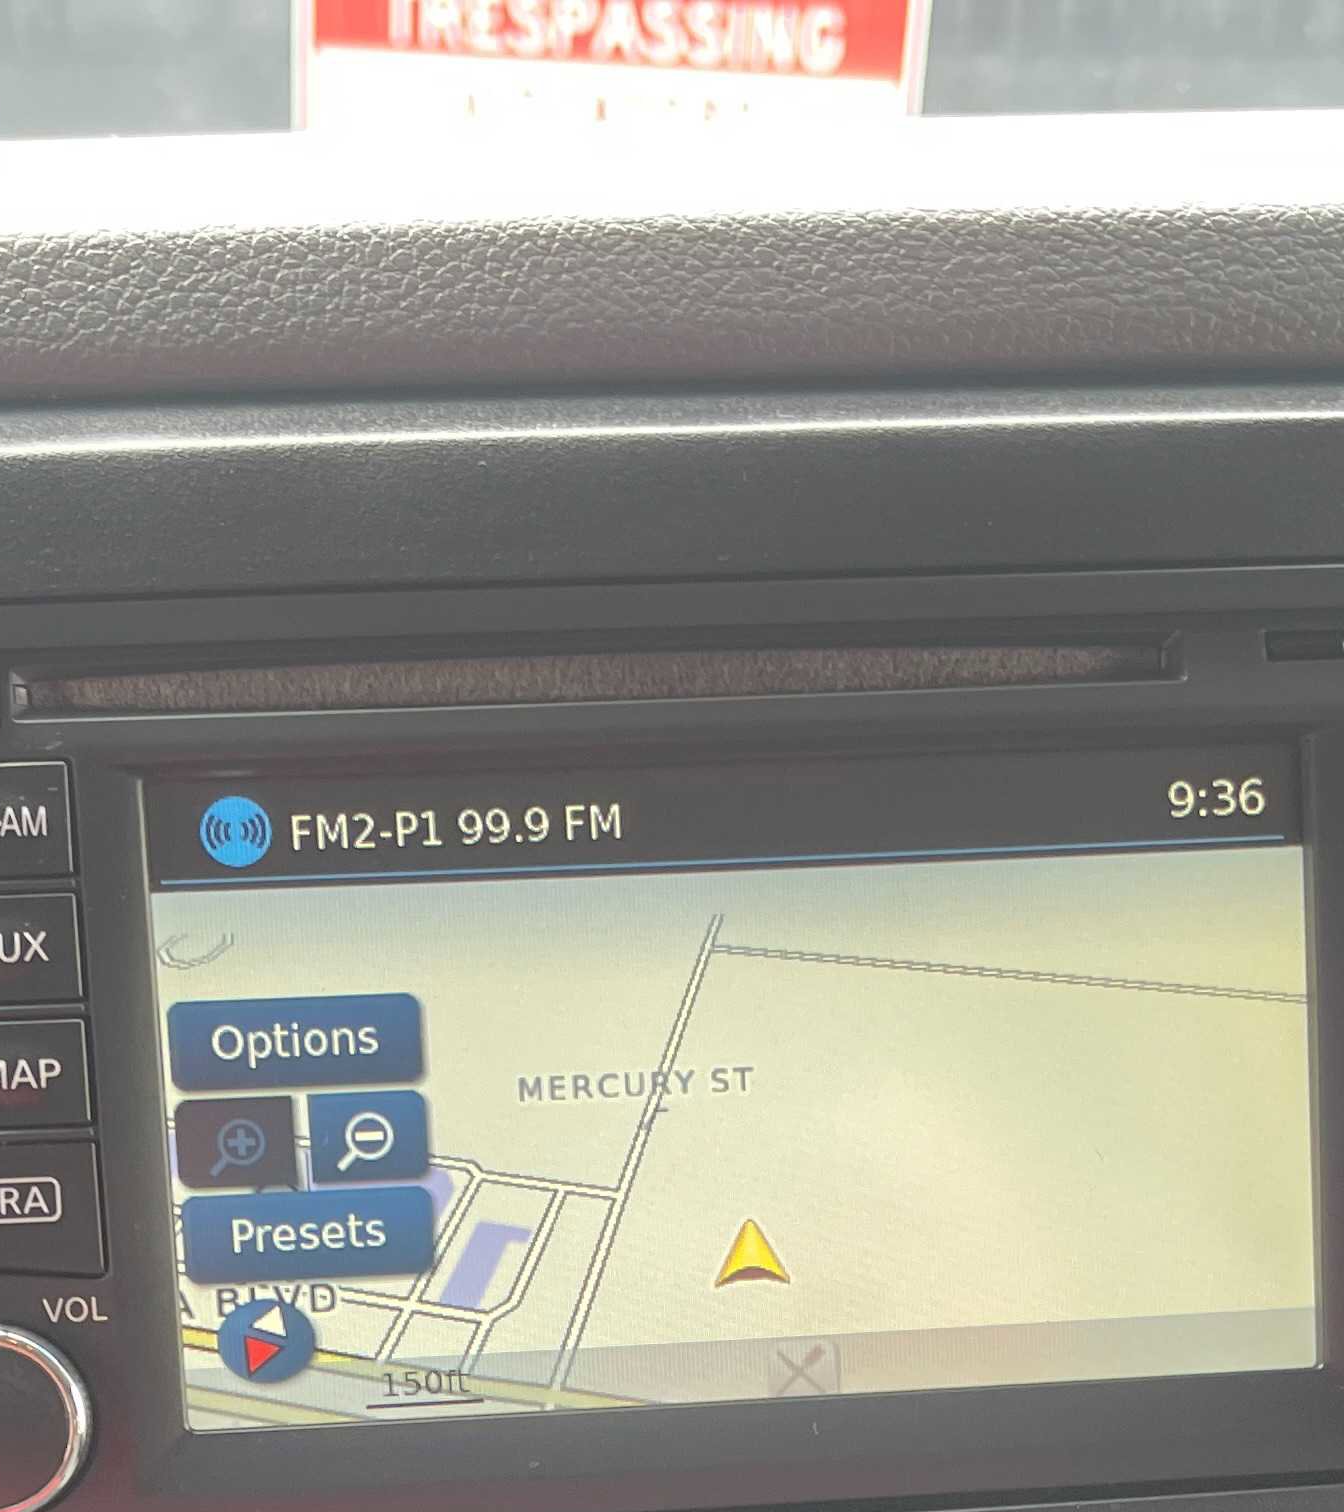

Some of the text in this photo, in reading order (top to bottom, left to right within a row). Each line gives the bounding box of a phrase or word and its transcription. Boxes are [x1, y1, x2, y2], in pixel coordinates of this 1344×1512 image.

[388, 0, 846, 73] TRESPASSING
[1167, 777, 1266, 818] 9:36
[290, 803, 623, 851] FM2-P1 99.9 FM
[210, 1023, 380, 1070] Options
[517, 1066, 754, 1102] MERCURY ST
[230, 1213, 387, 1255] Presets
[42, 1296, 109, 1324] VOL
[382, 1369, 473, 1398] 150ft
